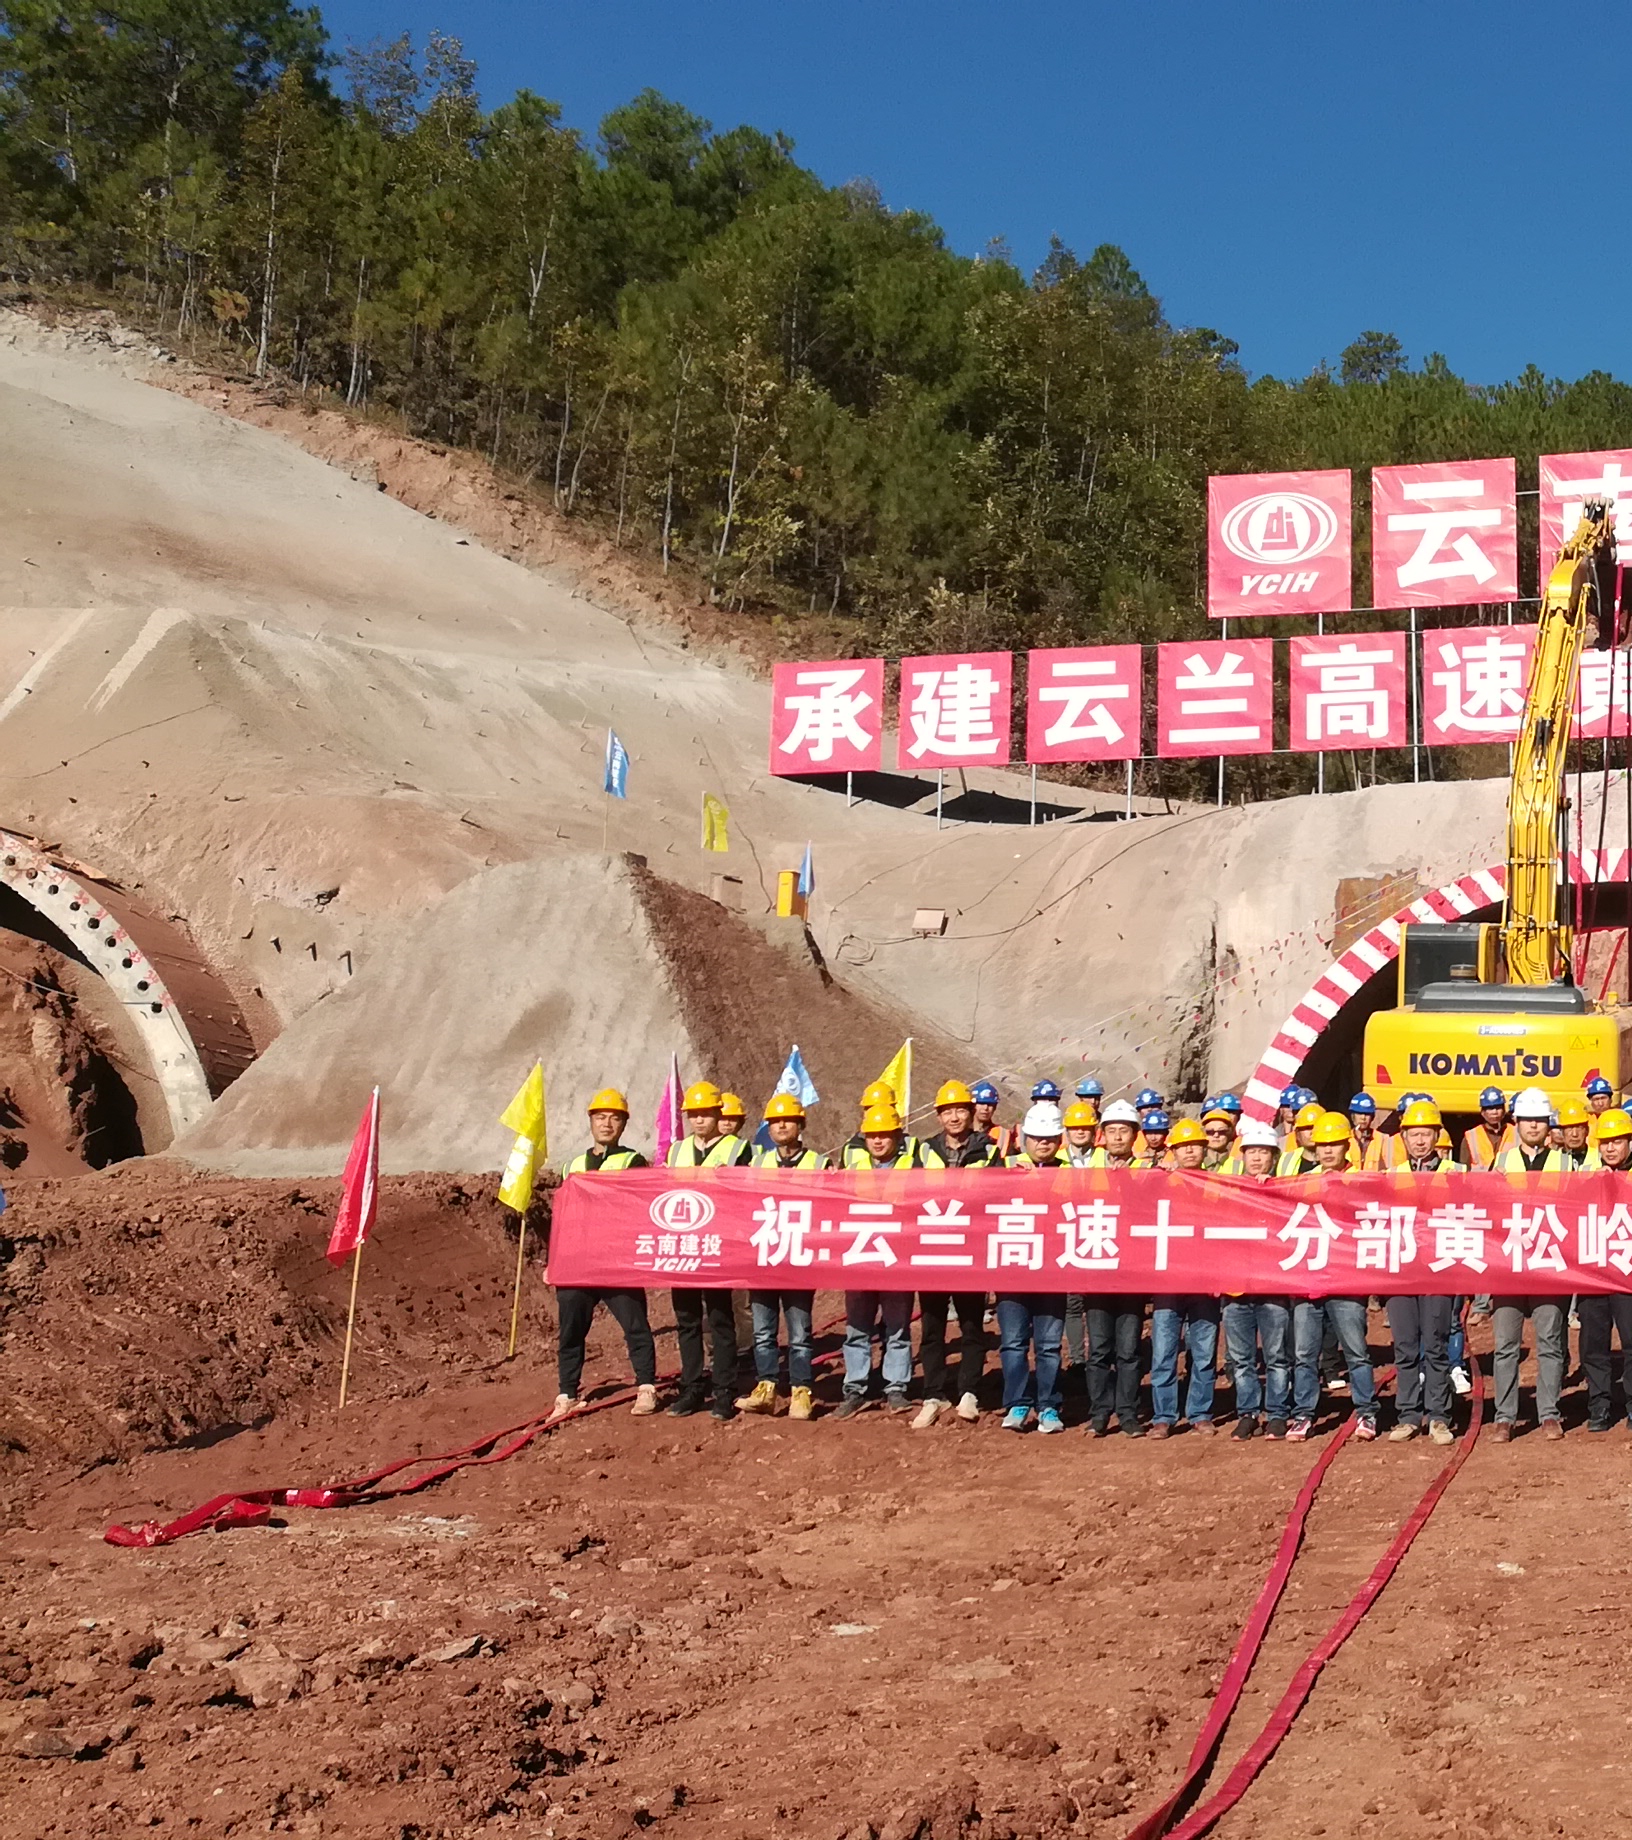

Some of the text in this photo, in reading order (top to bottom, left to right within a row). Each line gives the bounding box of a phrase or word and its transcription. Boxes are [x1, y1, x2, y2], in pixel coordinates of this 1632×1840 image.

[1240, 572, 1319, 596] YCIH
[1409, 1049, 1562, 1077] KOMATSU
[634, 1233, 722, 1256] 云南建投
